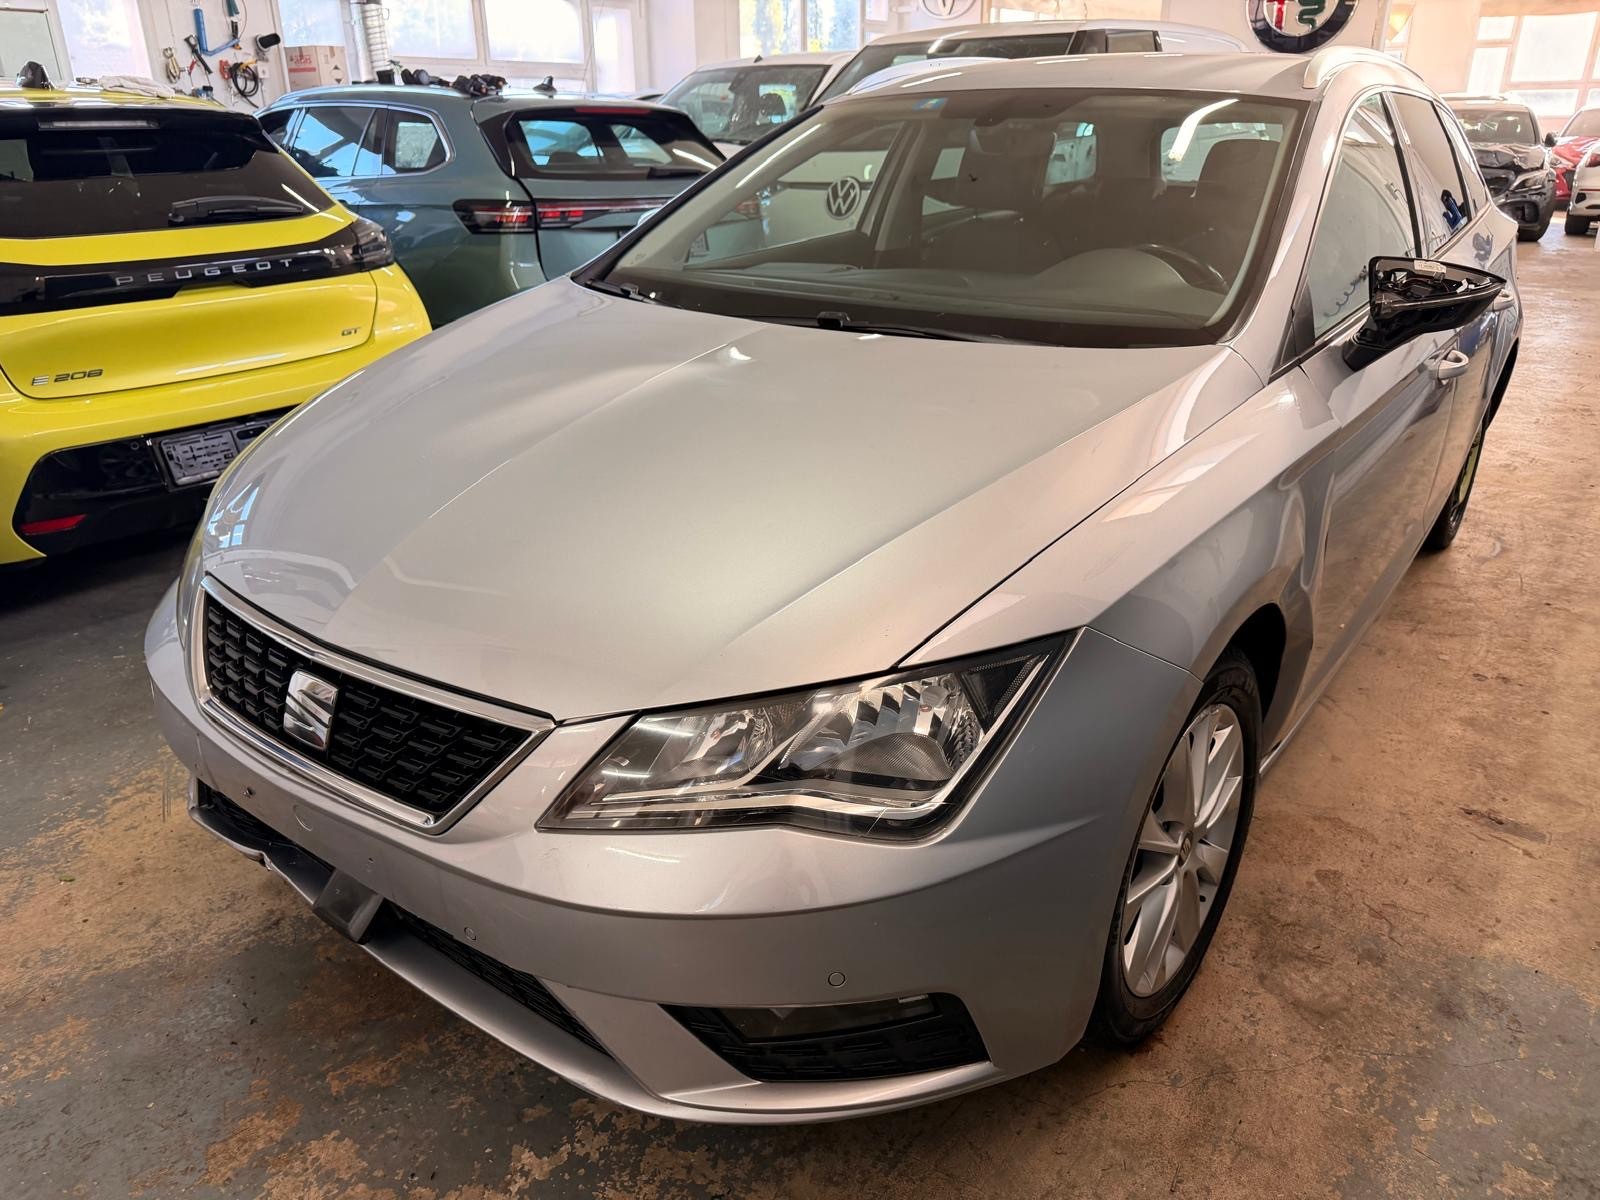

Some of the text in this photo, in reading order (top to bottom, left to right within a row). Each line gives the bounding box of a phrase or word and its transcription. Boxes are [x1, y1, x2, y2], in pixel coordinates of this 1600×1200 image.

[115, 258, 293, 286] PEUGEOT
[341, 326, 362, 337] GT
[31, 368, 104, 387] E 208
